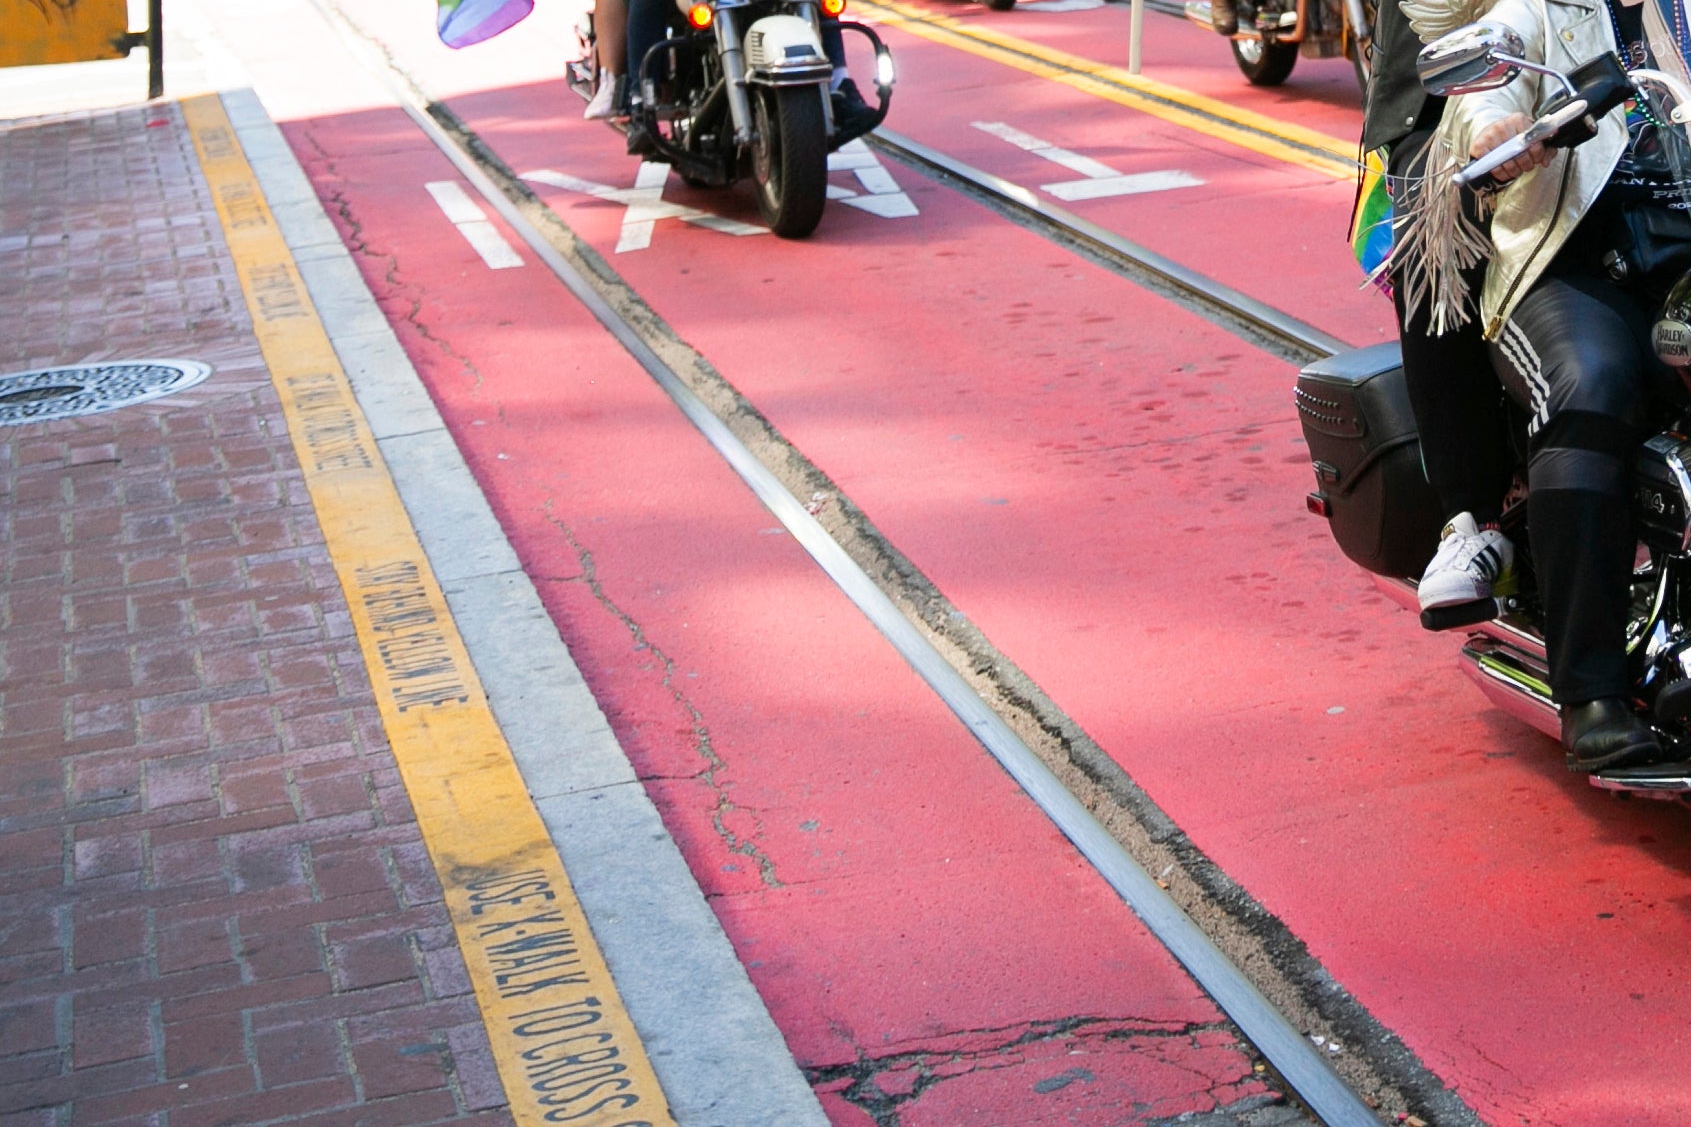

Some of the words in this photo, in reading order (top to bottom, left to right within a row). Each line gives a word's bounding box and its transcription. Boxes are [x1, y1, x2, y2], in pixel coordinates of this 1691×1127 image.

[377, 628, 457, 680] YELLOW
[392, 678, 469, 712] LINE
[465, 869, 556, 915] USE
[477, 909, 590, 999] X-WALK
[508, 997, 602, 1036] TO
[521, 1032, 639, 1122] CROSS
